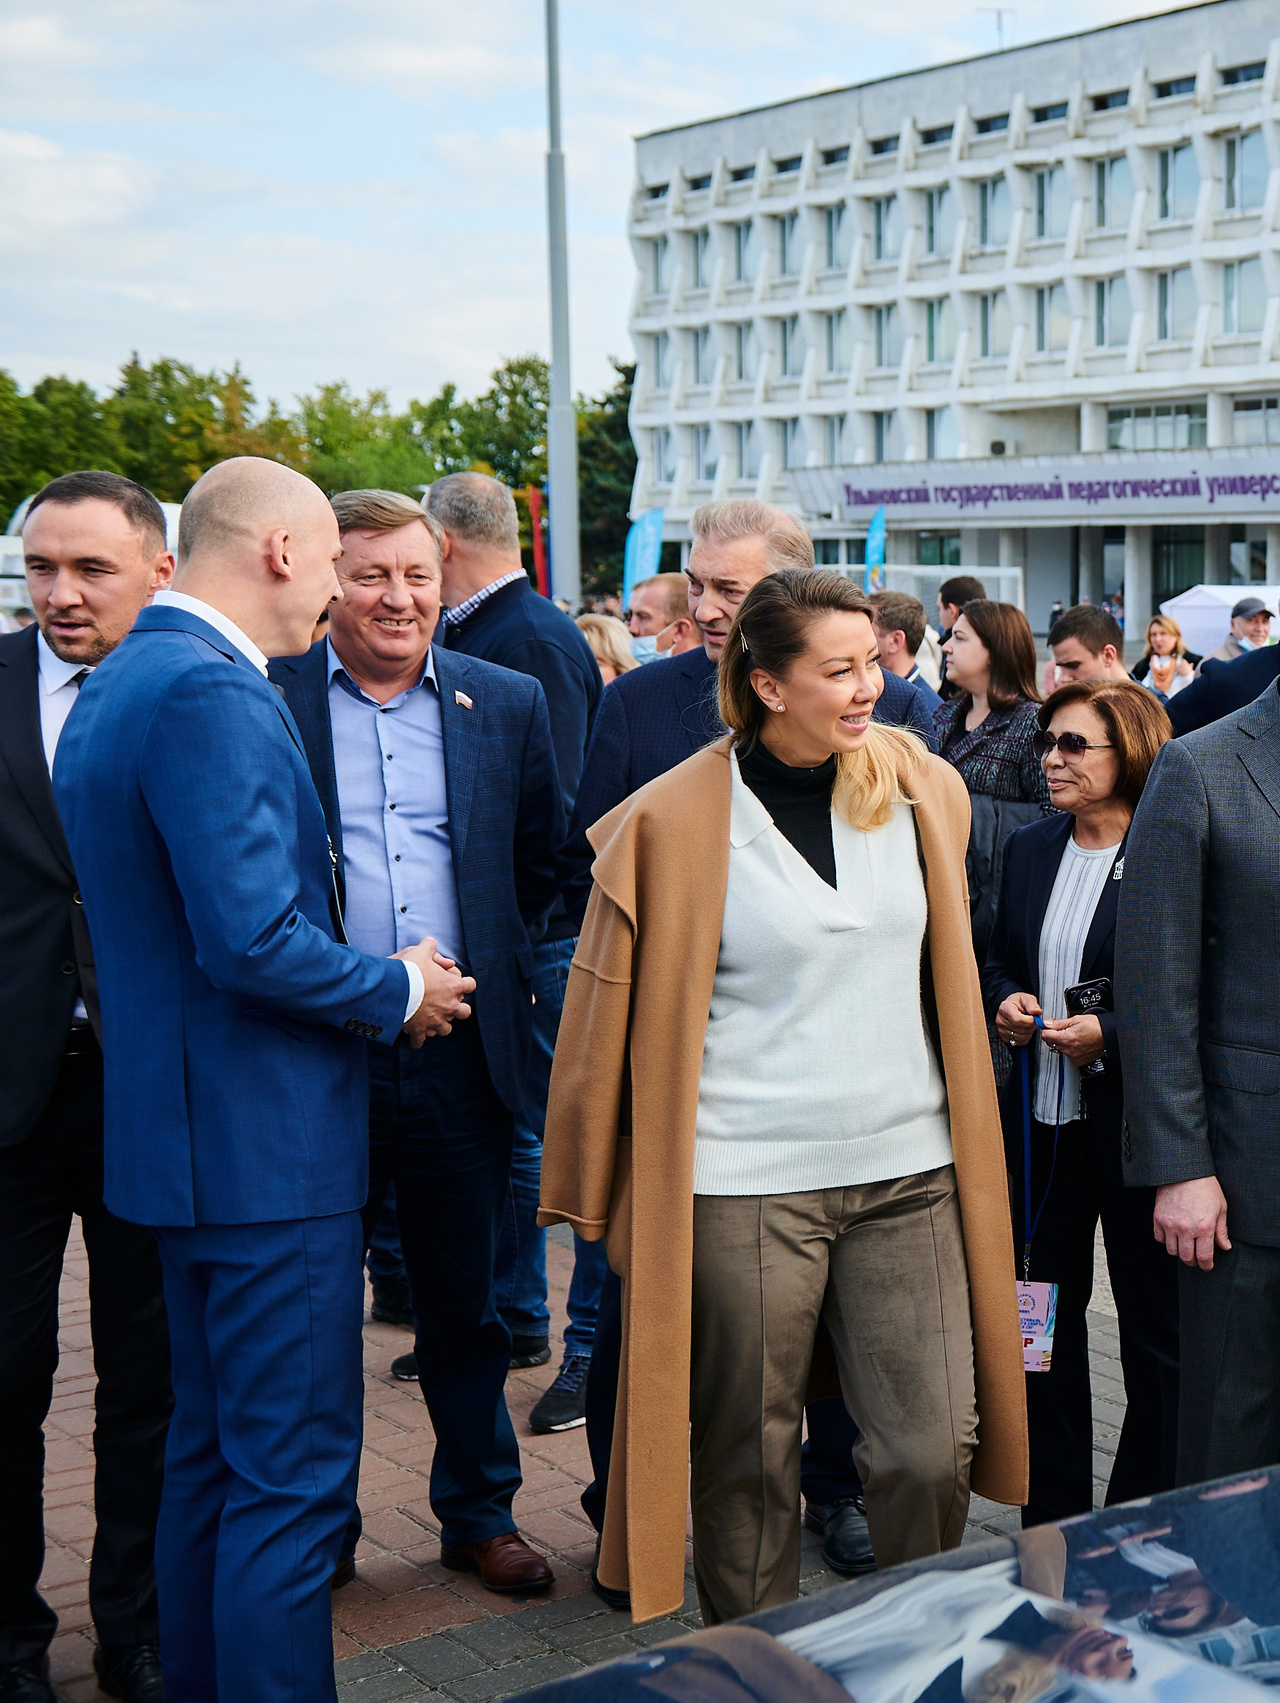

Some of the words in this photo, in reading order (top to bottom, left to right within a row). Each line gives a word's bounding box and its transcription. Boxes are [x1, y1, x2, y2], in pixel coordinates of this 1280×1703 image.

[844, 480, 930, 506] Ульяновский
[934, 475, 1063, 509] государственный
[1068, 470, 1201, 504] педагогический
[1079, 993, 1102, 1005] 16:45
[1022, 1338, 1034, 1348] P
